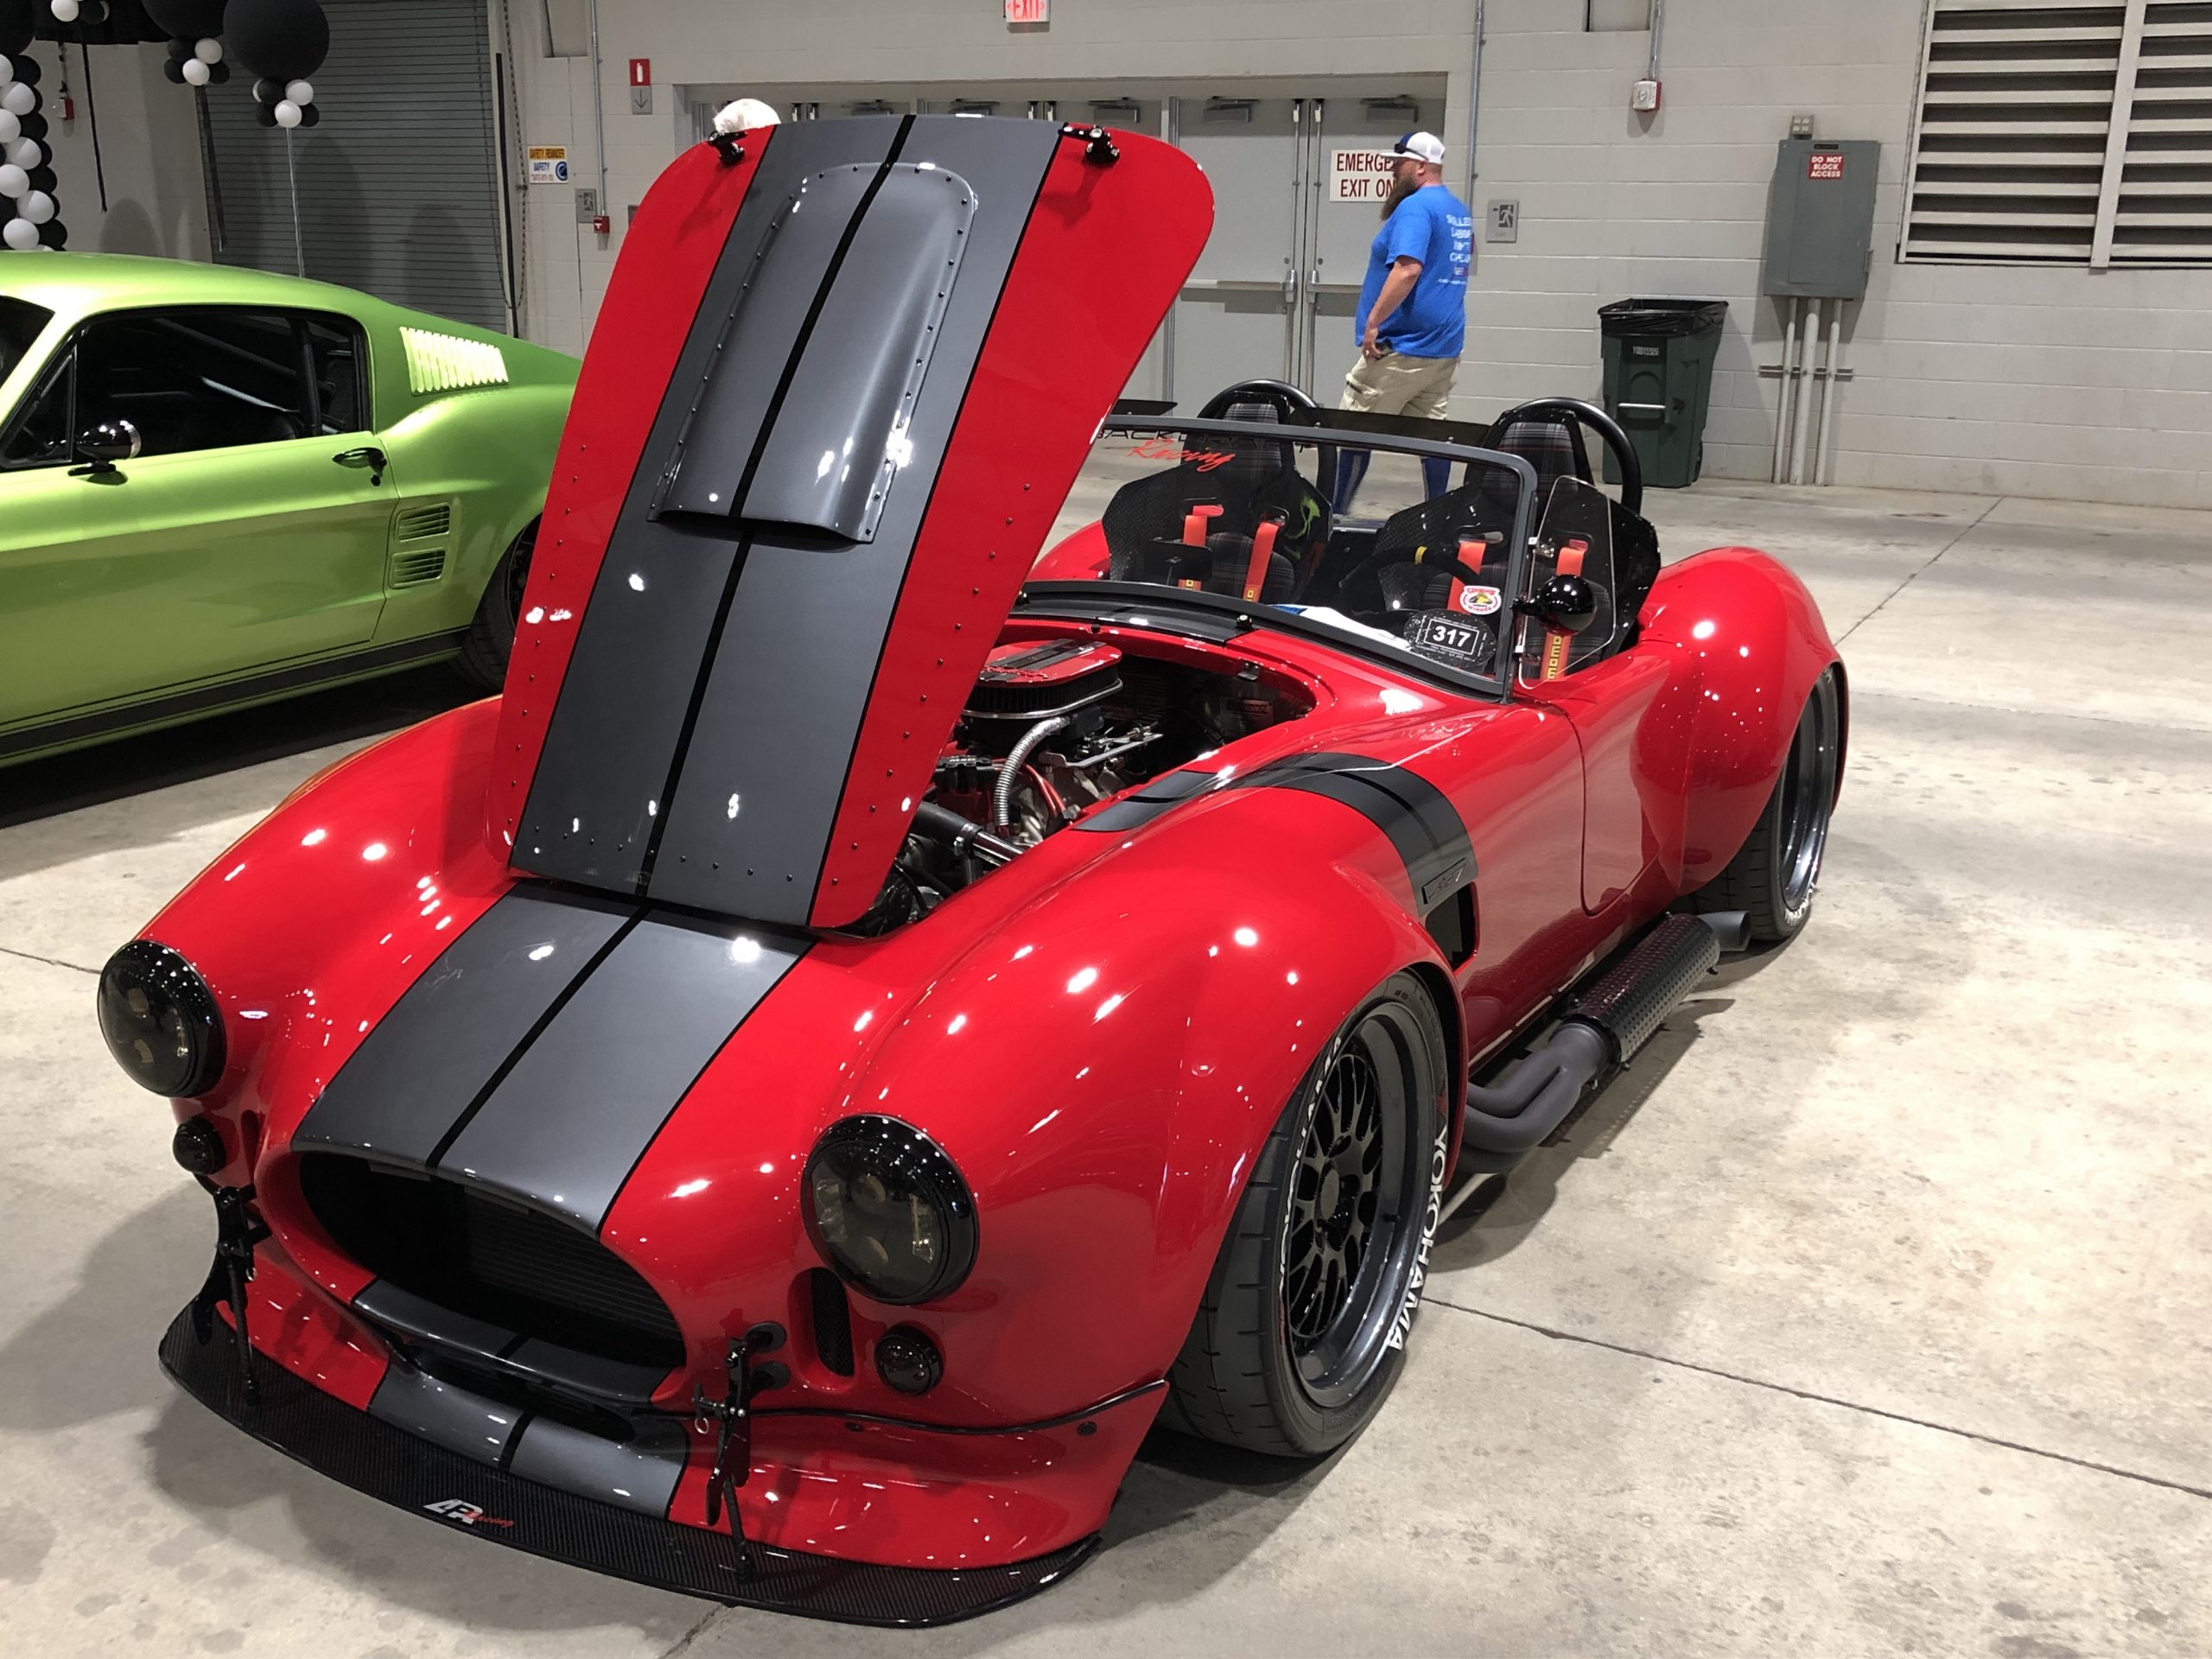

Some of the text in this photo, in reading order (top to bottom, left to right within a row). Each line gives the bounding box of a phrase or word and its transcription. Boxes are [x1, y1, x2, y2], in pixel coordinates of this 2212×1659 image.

[1012, 0, 1039, 19] EXIT
[1340, 179, 1370, 197] EXIT
[1432, 625, 1471, 648] 317
[1389, 1124, 1448, 1351] YOKOHAMA
